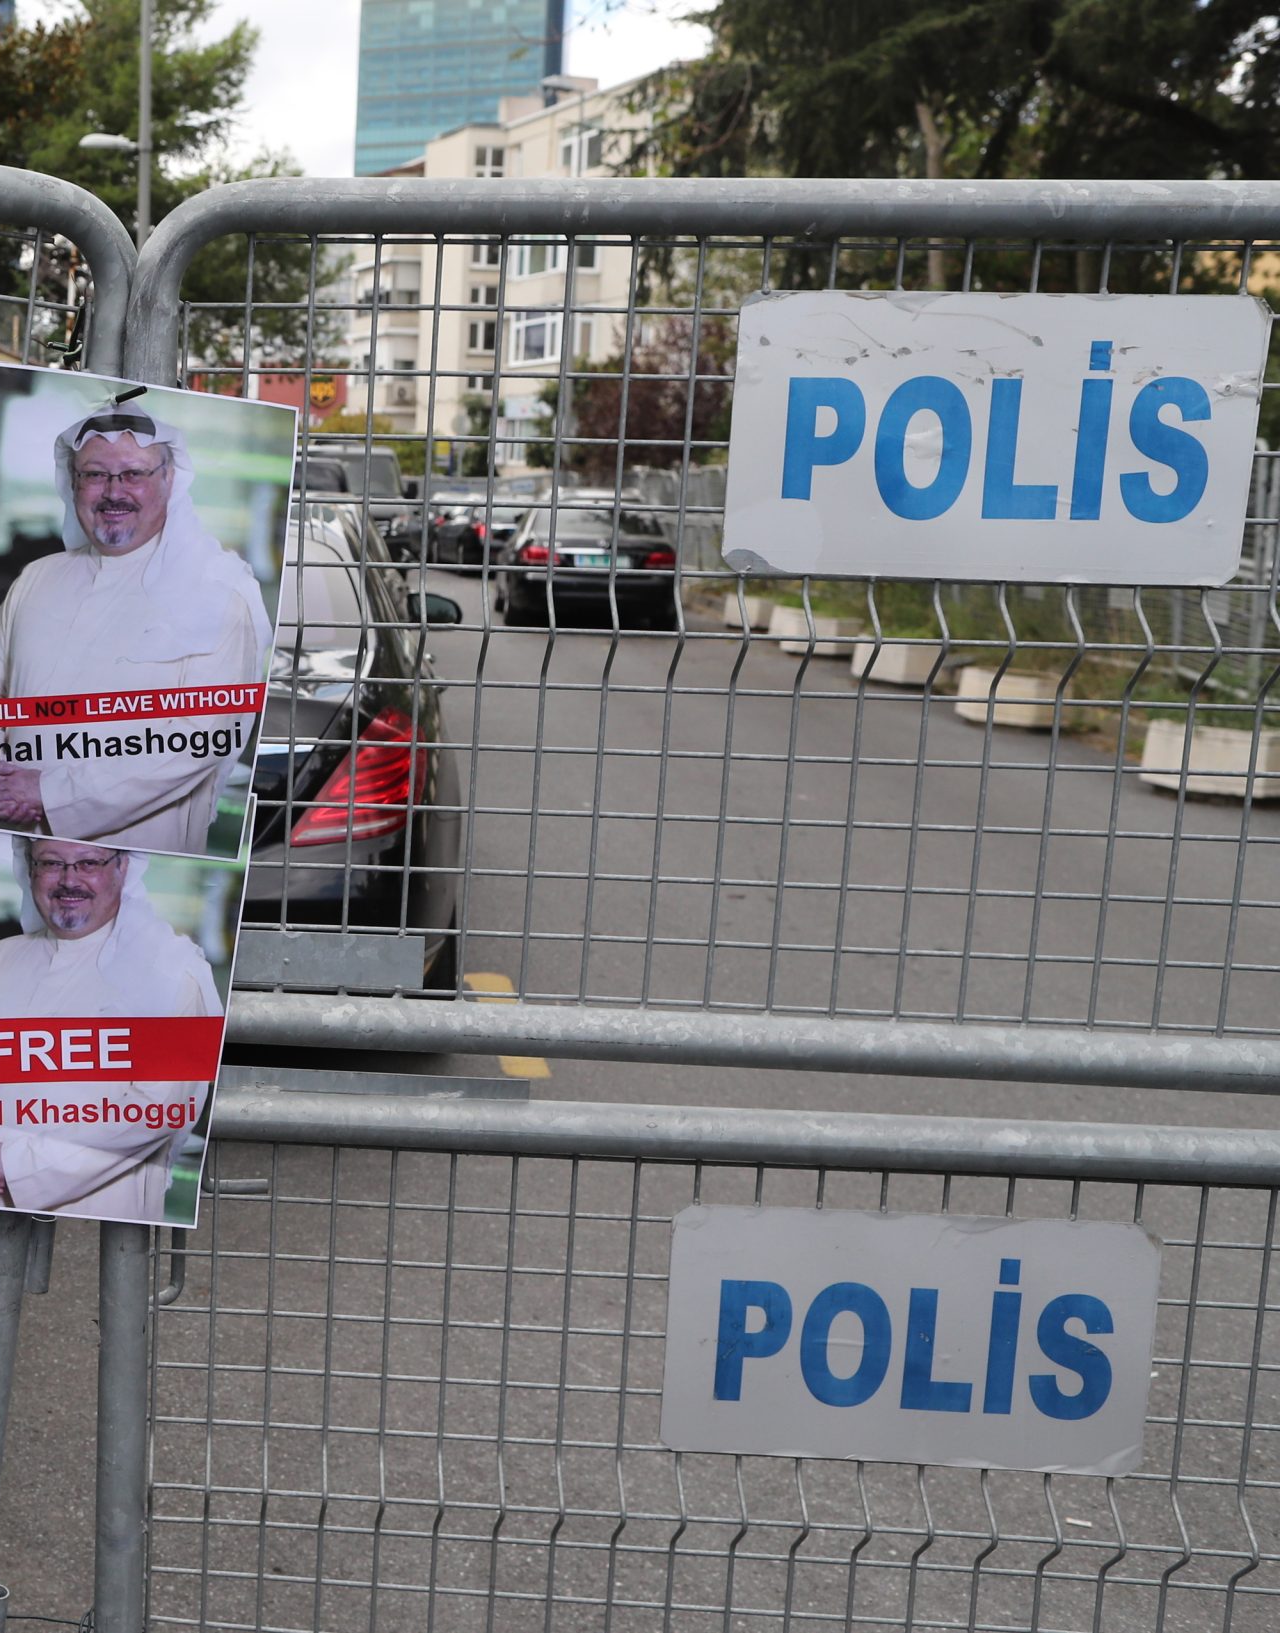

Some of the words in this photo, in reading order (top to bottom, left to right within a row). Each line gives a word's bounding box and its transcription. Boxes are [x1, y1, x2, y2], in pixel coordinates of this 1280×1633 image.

[781, 341, 1212, 524] POLİS
[35, 700, 79, 719] NOT
[85, 695, 154, 716] LEAVE
[159, 688, 259, 711] WITHOUT
[55, 722, 243, 760] Khashoggi
[16, 1097, 196, 1130] Khashoggi
[714, 1258, 1115, 1420] POLİS
